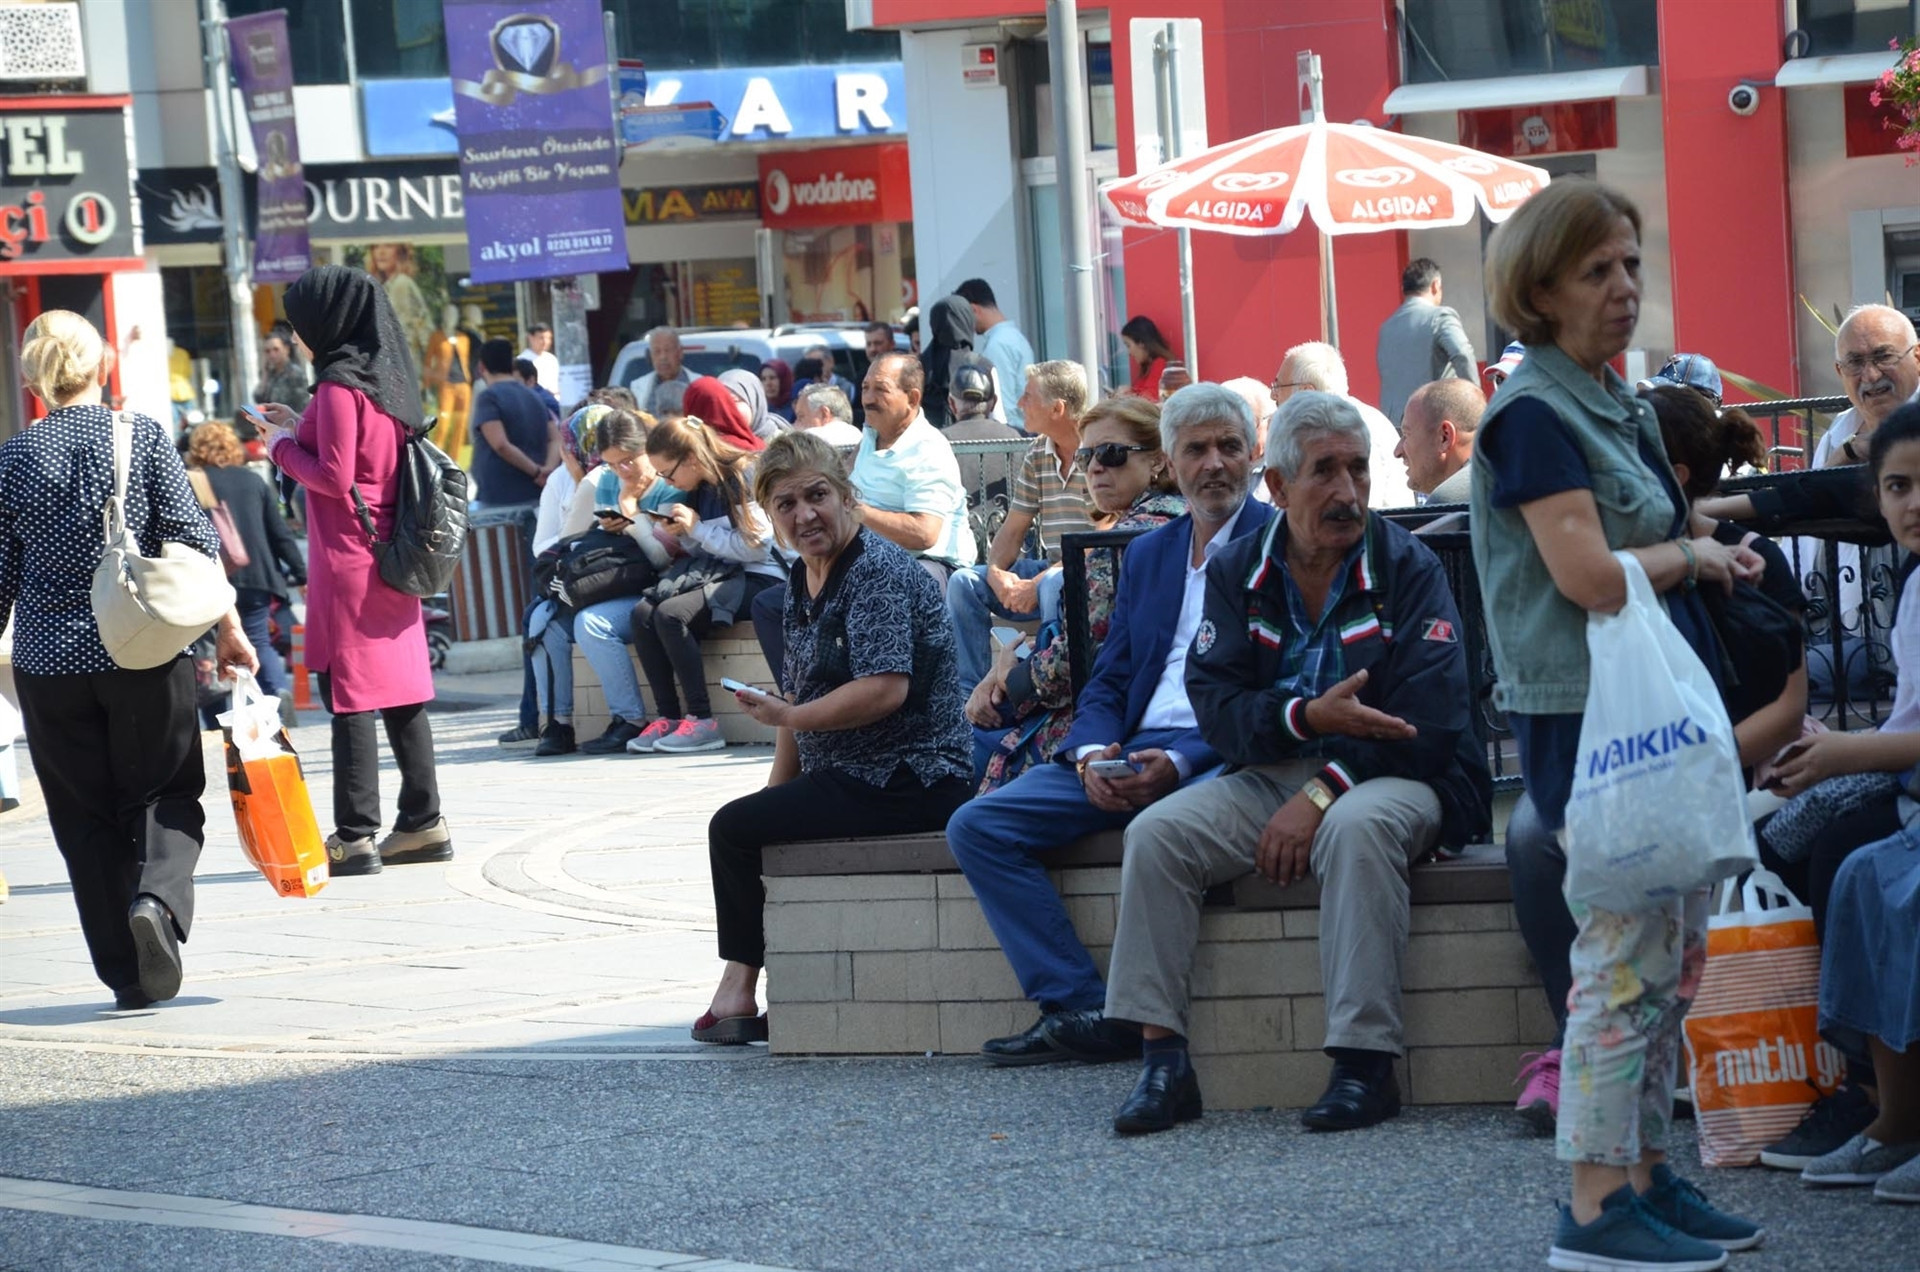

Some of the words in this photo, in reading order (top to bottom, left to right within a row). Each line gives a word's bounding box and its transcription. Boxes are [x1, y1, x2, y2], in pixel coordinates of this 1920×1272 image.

[523, 165, 550, 182] Bir
[702, 189, 757, 211] AVM
[793, 172, 876, 205] vodafone
[481, 237, 541, 263] akyol
[1716, 1036, 1808, 1087] mutlu
